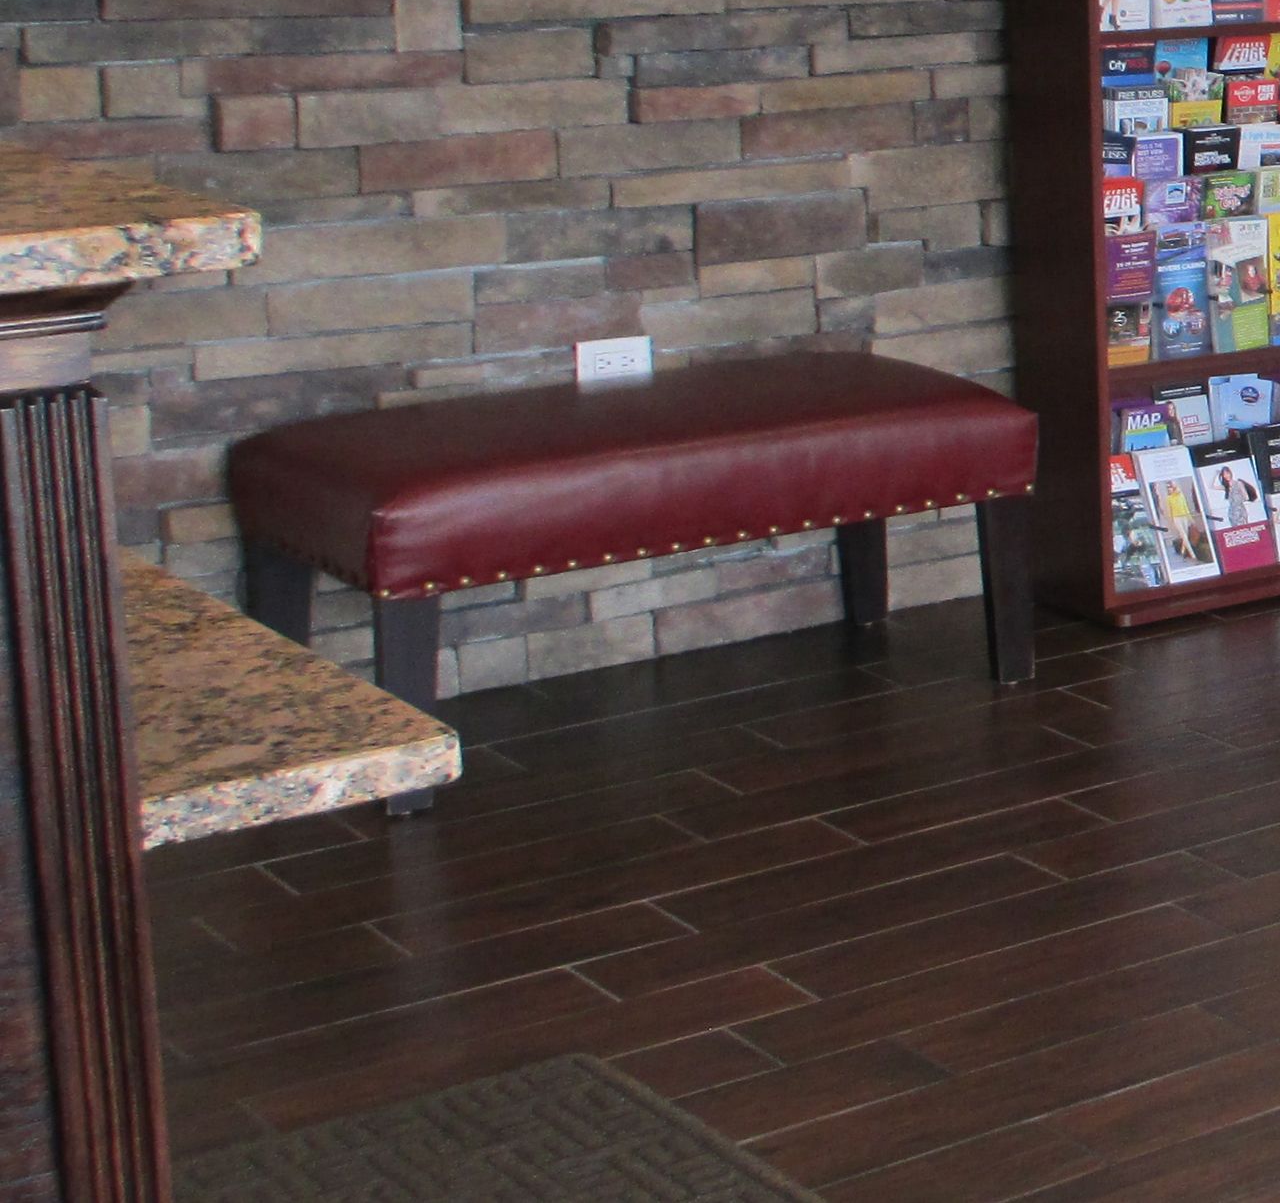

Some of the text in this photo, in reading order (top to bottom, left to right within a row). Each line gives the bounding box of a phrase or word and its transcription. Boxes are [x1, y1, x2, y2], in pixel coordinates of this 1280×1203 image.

[1118, 91, 1136, 100] FREE
[1258, 83, 1275, 93] FREE
[1102, 192, 1139, 214] EDGE
[1113, 311, 1128, 327] 25
[1127, 412, 1162, 430] MAP
